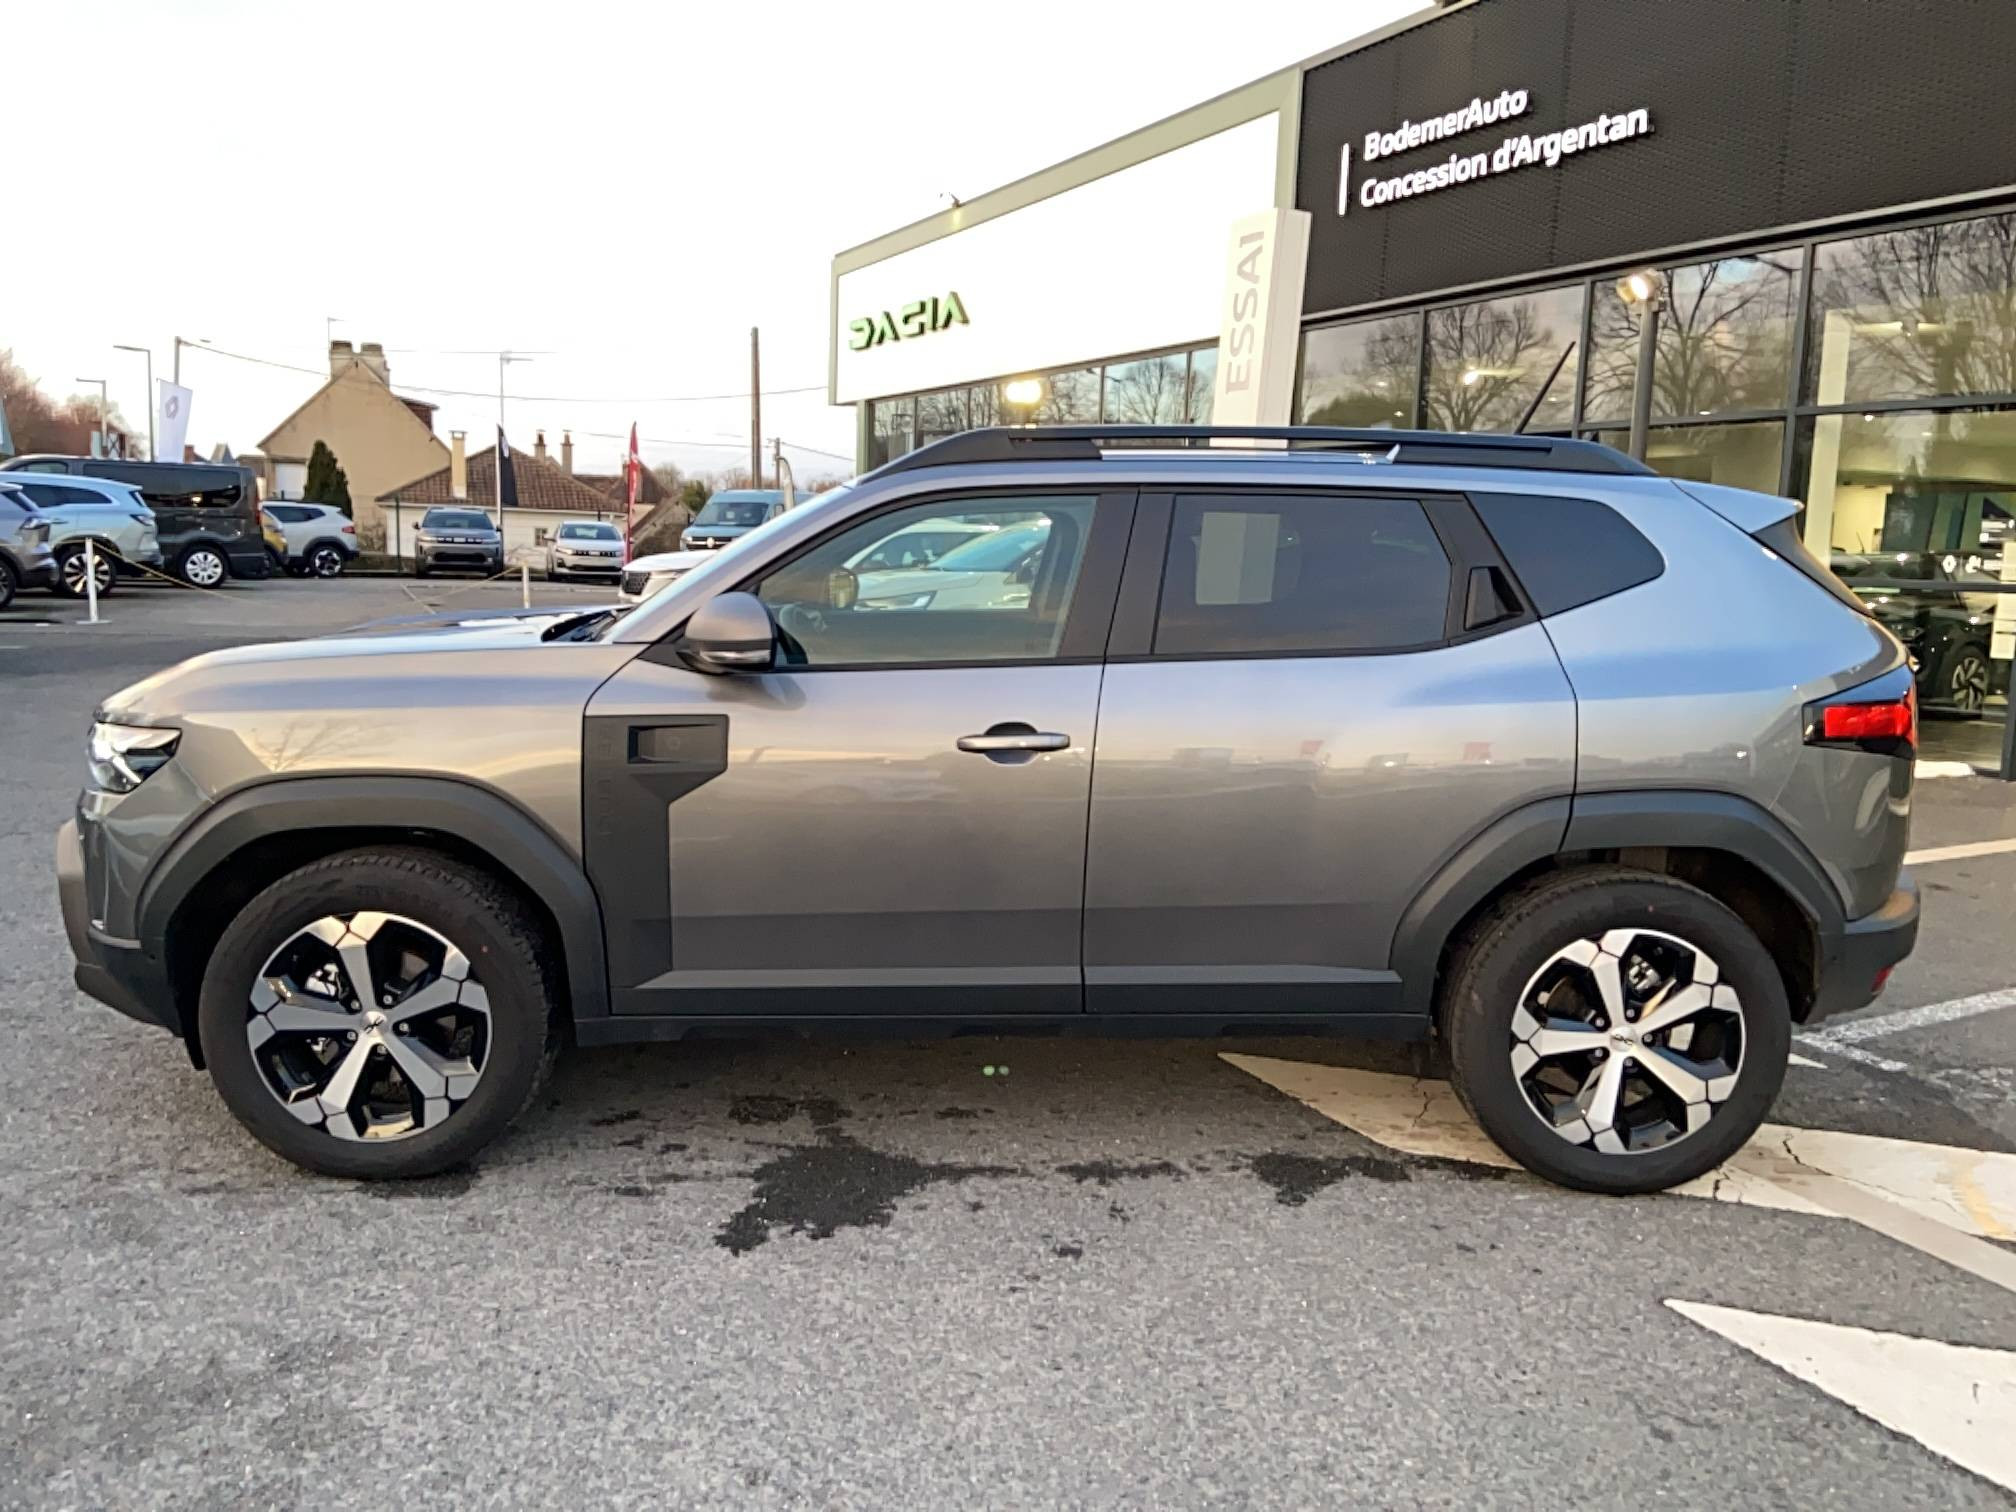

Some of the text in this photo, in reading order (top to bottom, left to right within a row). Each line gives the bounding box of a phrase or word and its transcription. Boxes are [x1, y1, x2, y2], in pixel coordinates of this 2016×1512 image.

[1360, 108, 1650, 207] Concession d'Argentan
[1363, 89, 1529, 162] BodemerAuto
[849, 290, 970, 352] DACIA
[1225, 231, 1265, 395] ESSAI
